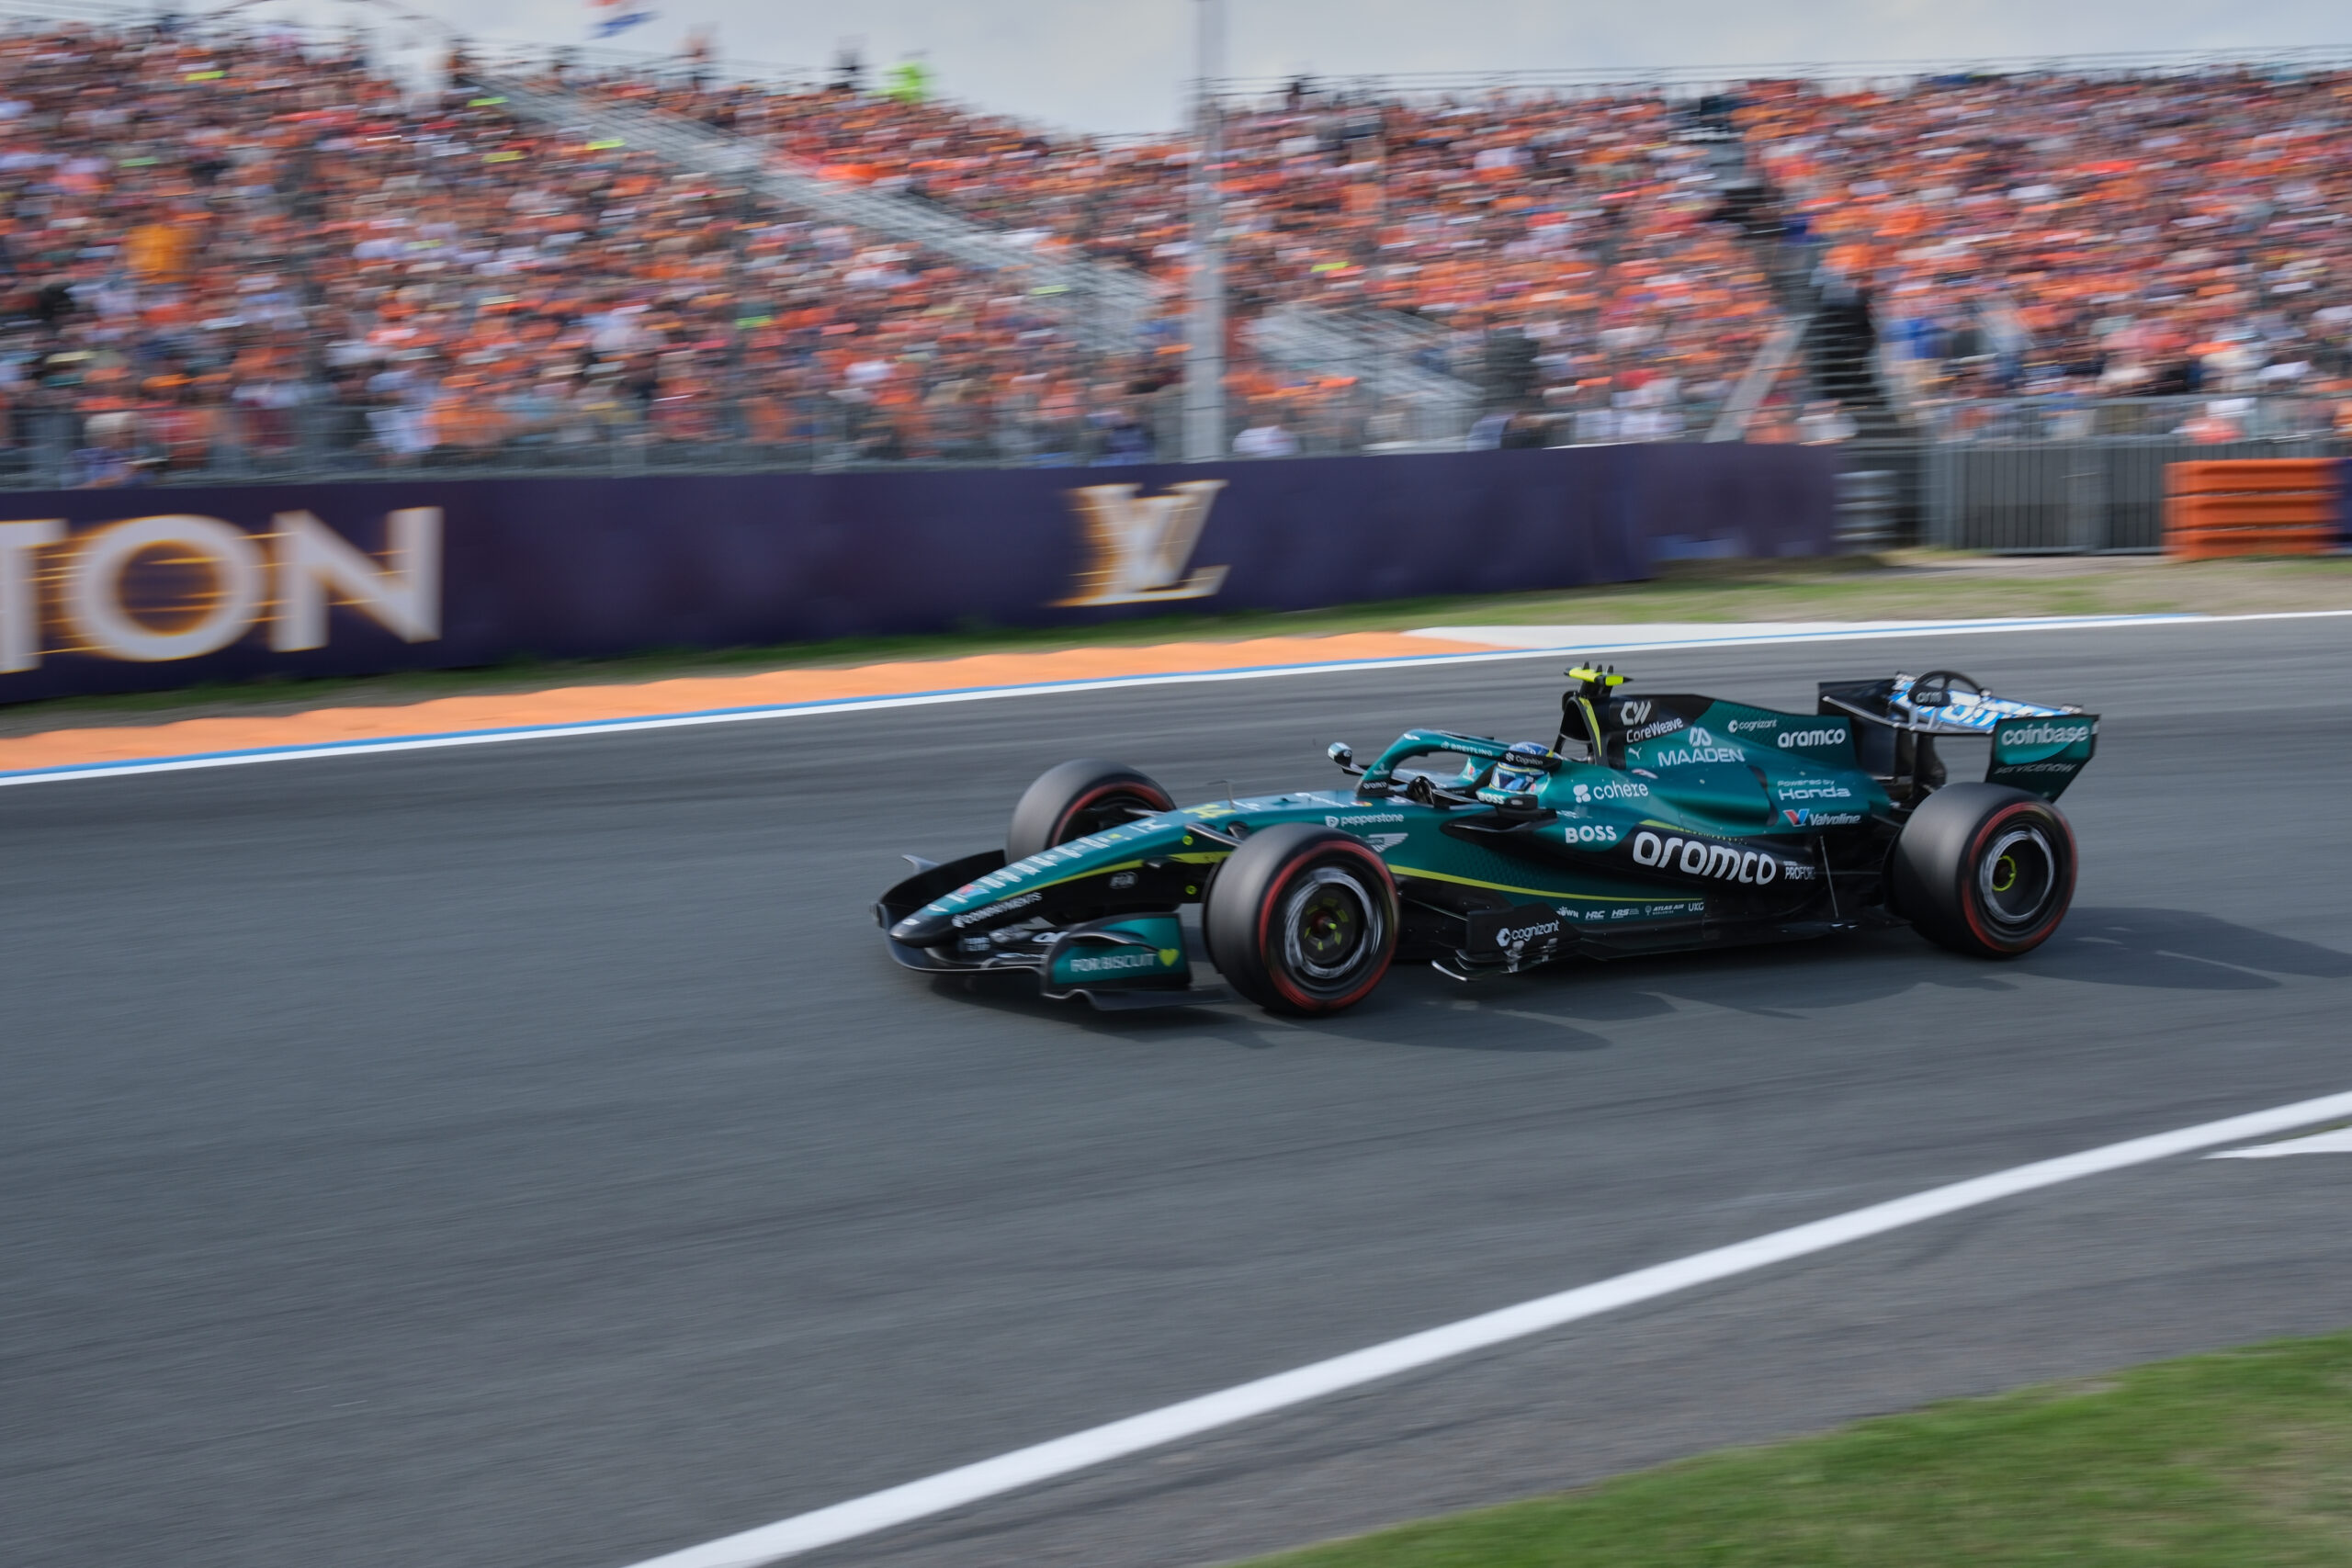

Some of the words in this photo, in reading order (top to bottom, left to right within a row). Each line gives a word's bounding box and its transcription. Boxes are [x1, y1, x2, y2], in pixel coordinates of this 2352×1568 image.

[1626, 717, 1683, 744] CoreWeave
[1778, 728, 1847, 749] aramco
[2001, 721, 2088, 746] coinbase
[1451, 743, 1493, 758] BREITLING
[1657, 748, 1746, 768] MAADEN
[1593, 781, 1649, 799] cohere
[1777, 779, 1822, 787] Powered
[1778, 786, 1852, 801] Honda
[1340, 812, 1405, 827] pepperstone
[1809, 813, 1861, 826] Valvoline
[1565, 825, 1617, 844] BOSS
[1633, 830, 1777, 886] aramco
[1510, 919, 1560, 942] cognizant
